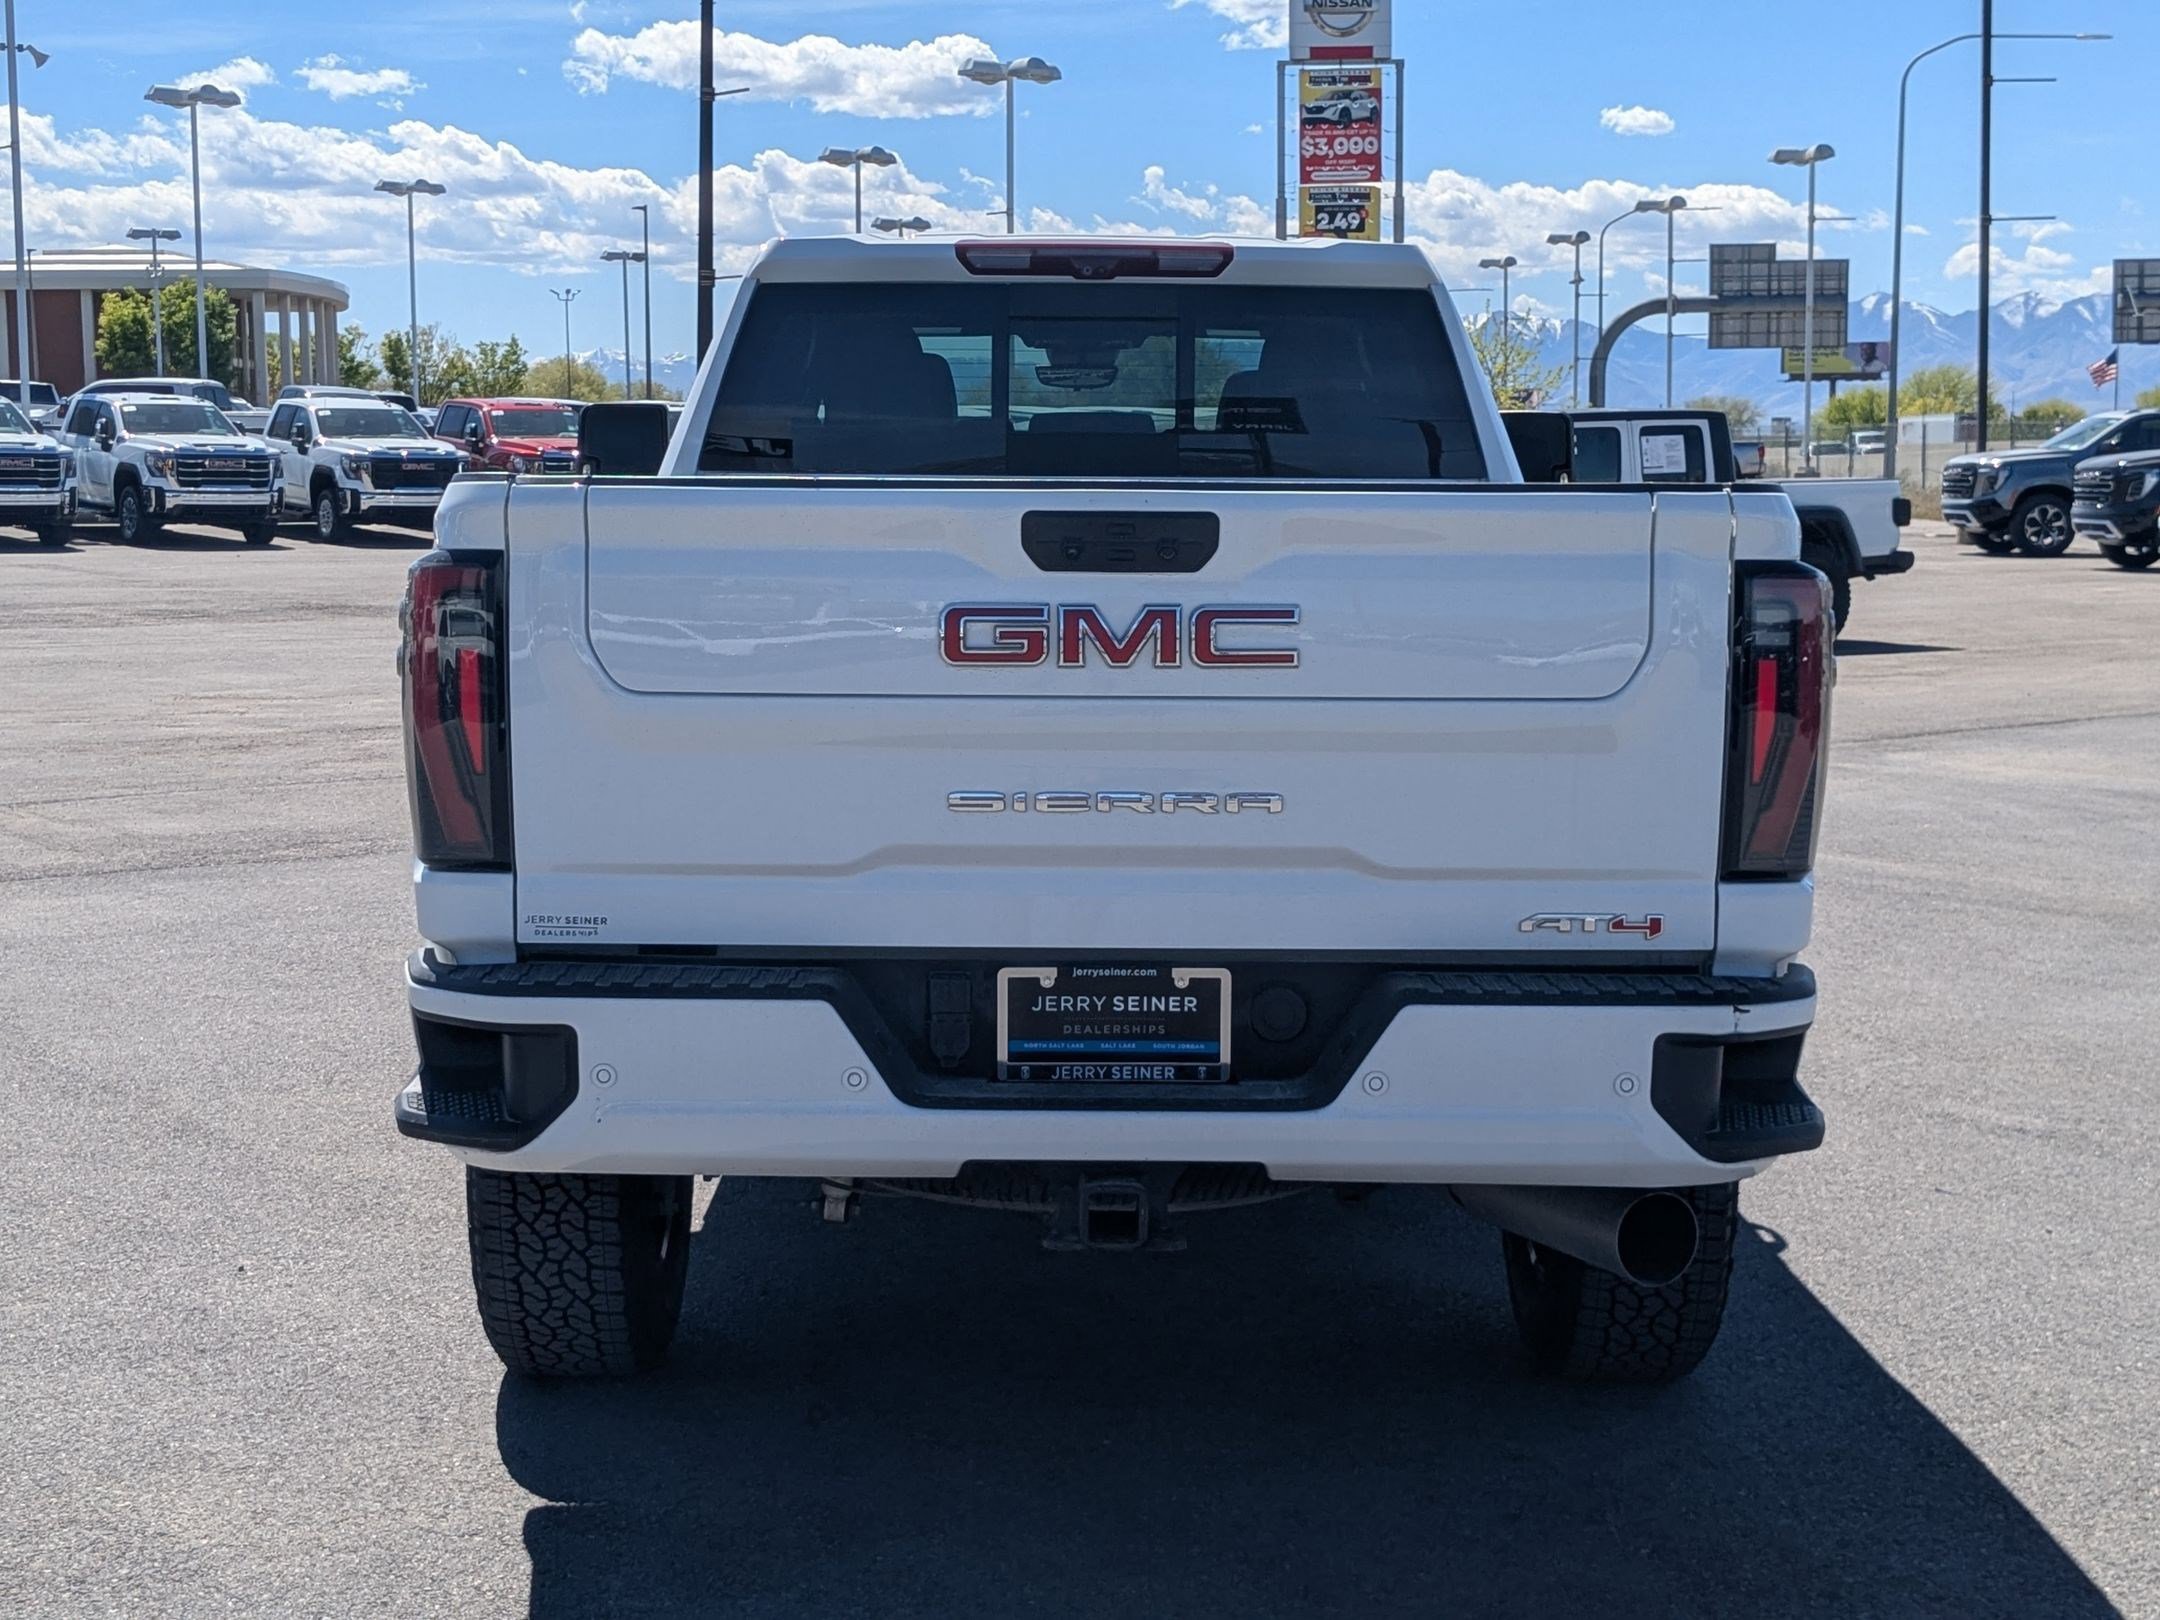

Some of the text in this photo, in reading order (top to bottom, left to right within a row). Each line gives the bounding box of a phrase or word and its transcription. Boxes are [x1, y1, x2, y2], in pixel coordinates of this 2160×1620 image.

[1311, 0, 1373, 8] NISSAN
[1301, 136, 1379, 159] $3,000
[1316, 212, 1361, 230] 2.49
[209, 458, 244, 469] GMC
[402, 463, 435, 471] GMC
[939, 602, 1300, 668] GMC
[947, 791, 1285, 814] SIERRA
[524, 915, 608, 925] JERRY SEINER
[1519, 913, 1664, 940] AT4
[1072, 967, 1158, 977] jerryseiner.com
[1031, 996, 1198, 1012] JERRY SEINER
[1063, 1024, 1166, 1035] DEALERSHIPS
[1051, 1066, 1175, 1079] JERRY SEINER
